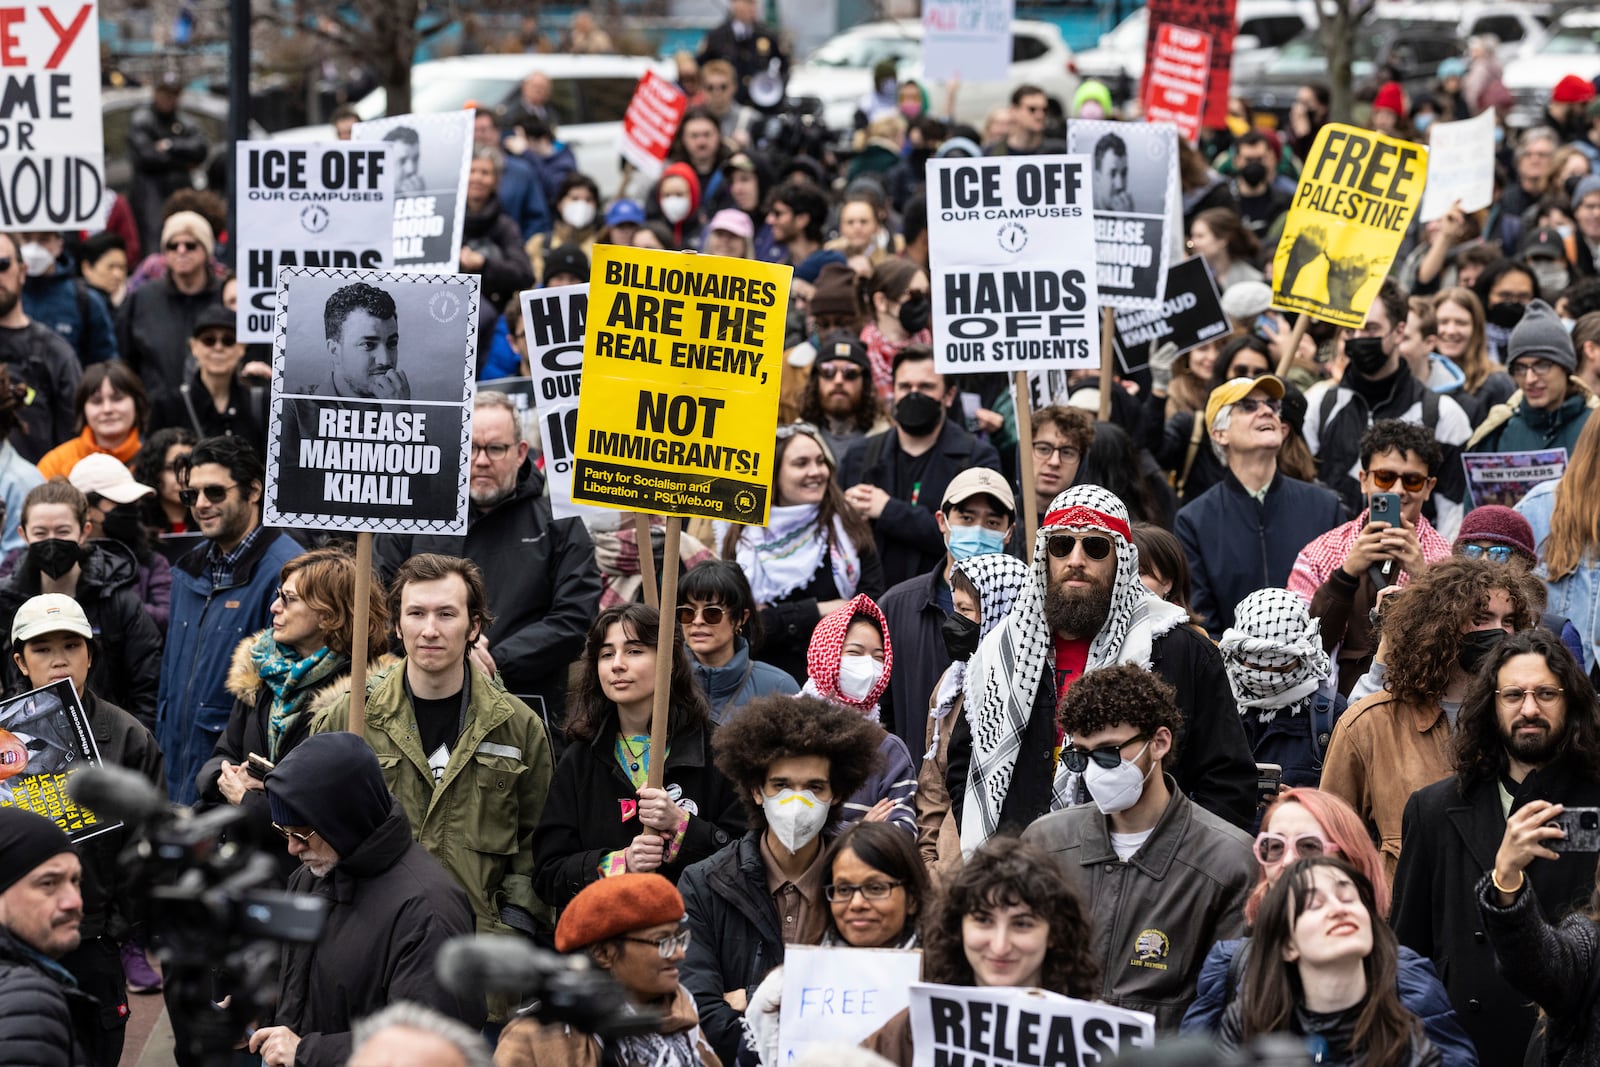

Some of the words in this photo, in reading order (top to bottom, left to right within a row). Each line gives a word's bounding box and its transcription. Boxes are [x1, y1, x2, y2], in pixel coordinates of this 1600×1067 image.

[249, 150, 307, 189] ICE
[321, 150, 385, 190] OFF
[1312, 130, 1418, 203] FREE
[0, 156, 101, 225] OUD
[248, 191, 285, 201] OUR
[288, 191, 384, 201] CAMPUSES
[939, 165, 1003, 209] ICE
[1016, 163, 1082, 207] OFF
[394, 196, 437, 219] EASE
[941, 210, 980, 222] OUR
[984, 207, 1083, 220] CAMPUSES
[1297, 182, 1408, 232] PALESTINE
[605, 260, 777, 307] BILLIONAIRES
[944, 269, 1087, 315] HANDS
[248, 314, 275, 333] OU
[606, 292, 685, 337] ARE
[696, 303, 767, 348] THE
[948, 314, 1085, 339] OFF
[596, 331, 663, 365] REAL
[670, 342, 768, 385] ENEMY,
[946, 342, 985, 362] OUR
[992, 339, 1089, 361] STUDENTS
[318, 408, 426, 442] RELEASE
[636, 389, 726, 439] NOT
[299, 438, 441, 475] MAHMOUD
[587, 429, 760, 476] IMMIGRANTS!
[323, 472, 413, 505] KHALIL
[585, 467, 613, 483] Party
[615, 471, 632, 484] for
[633, 474, 687, 492] Socialism
[689, 482, 711, 494] and
[1481, 470, 1504, 479] NEW
[1505, 468, 1554, 477] YORKERS
[583, 481, 639, 499] Liberation
[654, 491, 724, 511] PSLWeb.org
[38, 773, 63, 817] ACCEPT
[71, 820, 83, 830] A
[800, 987, 880, 1018] FREE
